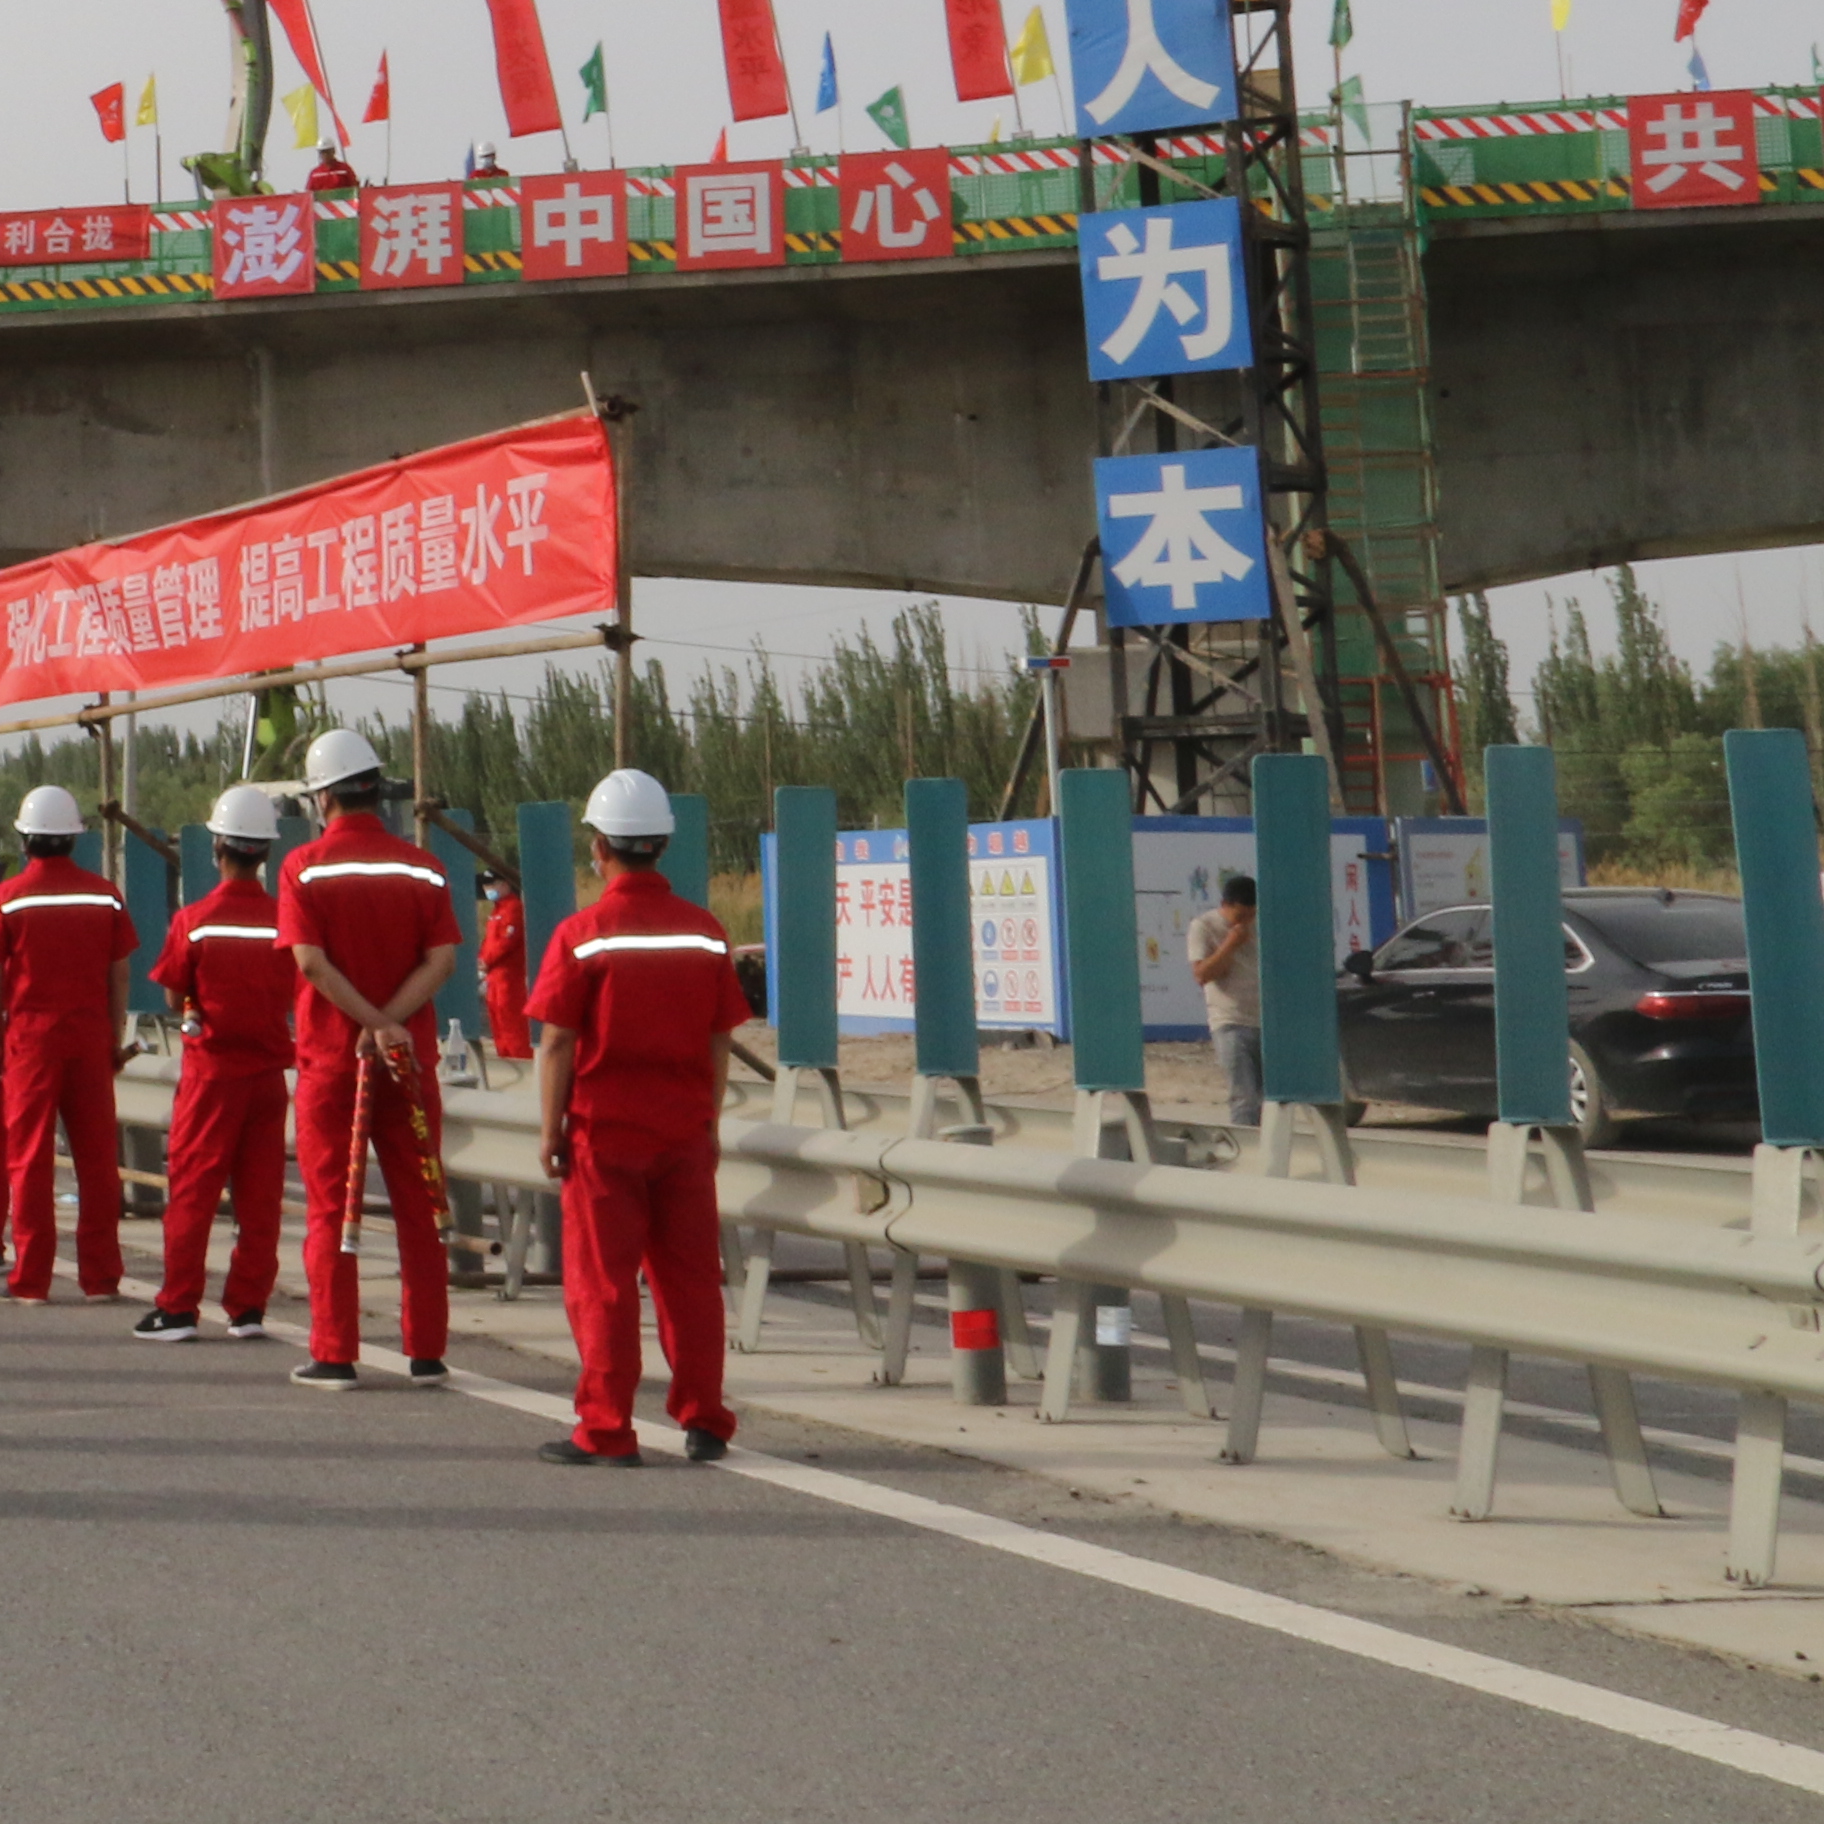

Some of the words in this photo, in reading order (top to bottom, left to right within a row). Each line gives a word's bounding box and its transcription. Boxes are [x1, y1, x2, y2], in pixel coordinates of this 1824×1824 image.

[1643, 102, 1746, 194] 共
[222, 161, 942, 287] 澎湃中国心
[7, 557, 224, 670] 强化工程质量管理
[240, 472, 550, 634] 提高工程质量水平
